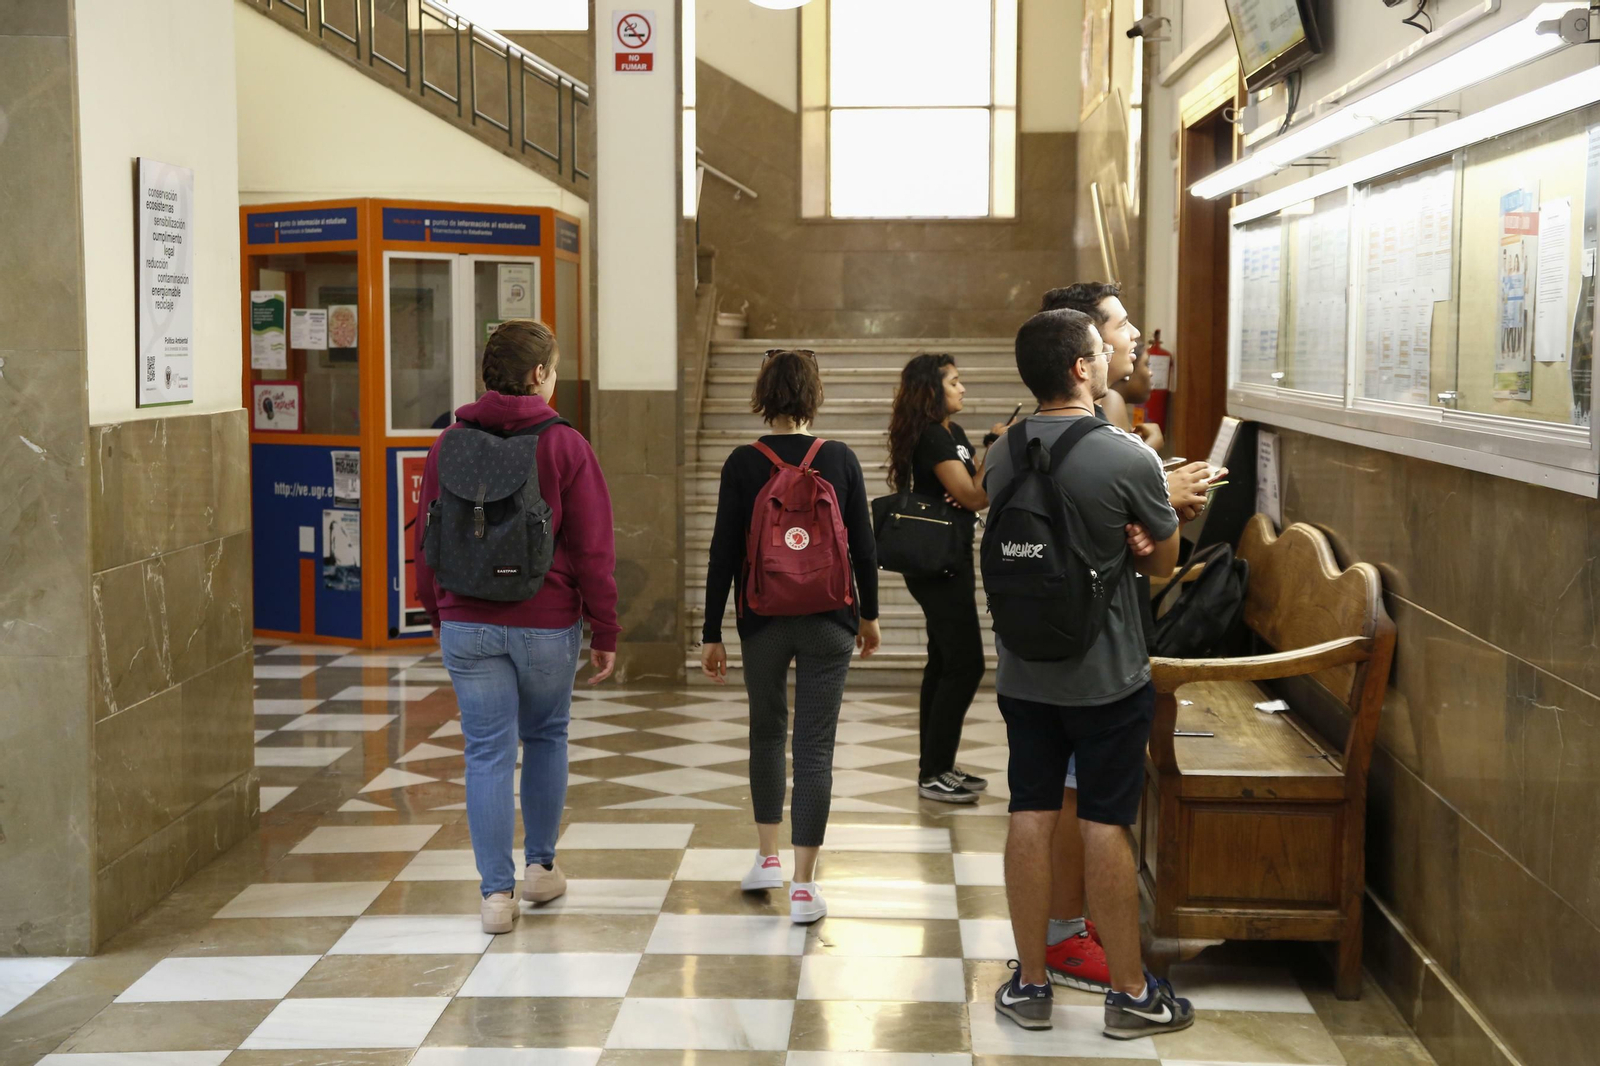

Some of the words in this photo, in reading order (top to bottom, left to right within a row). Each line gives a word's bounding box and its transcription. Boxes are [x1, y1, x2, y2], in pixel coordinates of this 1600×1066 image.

[148, 188, 177, 201] conservación
[146, 200, 174, 213] ecosistemas
[154, 216, 185, 230] sensibilización
[297, 218, 320, 226] información
[325, 217, 347, 225] estudiante
[457, 219, 490, 228] información
[498, 222, 526, 230] estudiante
[153, 231, 182, 244] cumplimiento
[164, 244, 174, 259] legal
[146, 257, 168, 269] reducción
[158, 273, 189, 284] contaminación
[155, 299, 174, 312] reciclaje
[1001, 541, 1043, 558] WASHER
